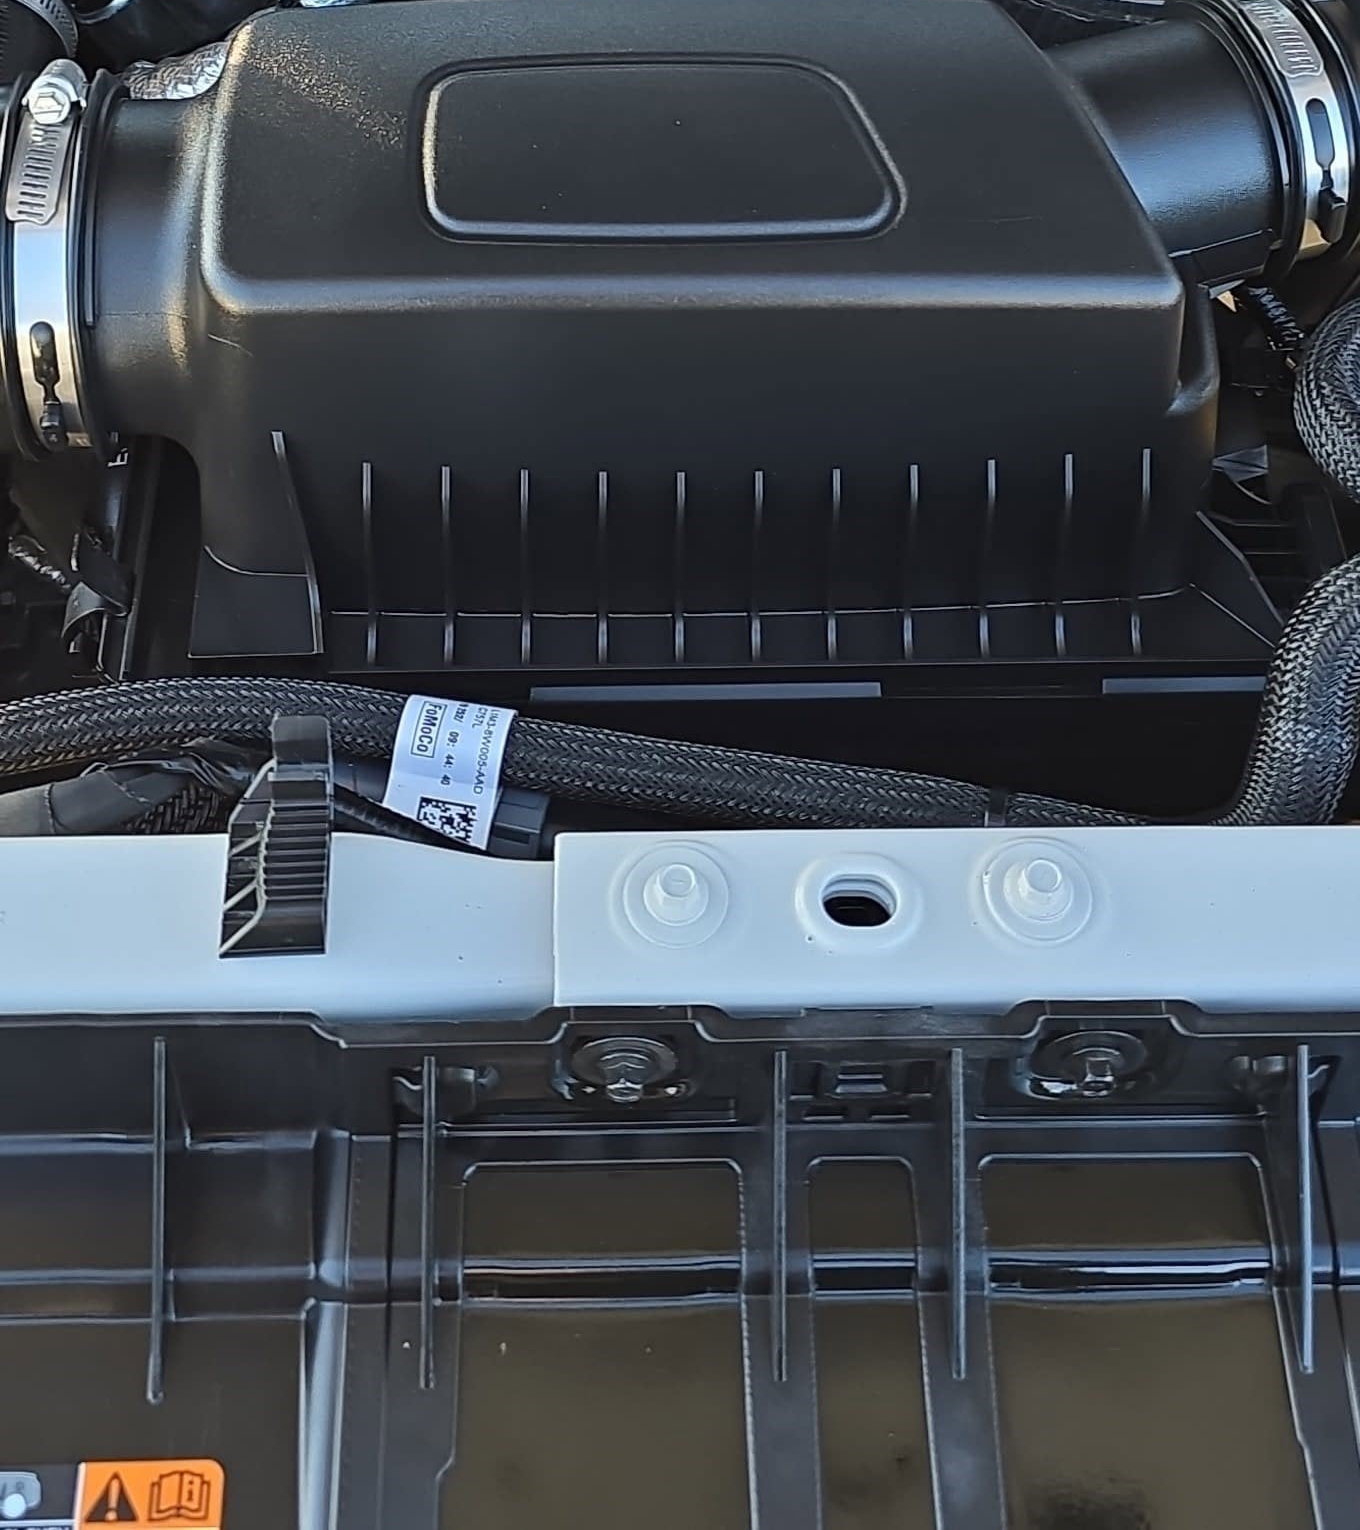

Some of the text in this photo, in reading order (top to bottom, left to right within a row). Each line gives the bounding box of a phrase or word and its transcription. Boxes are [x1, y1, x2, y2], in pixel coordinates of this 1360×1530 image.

[417, 703, 442, 752] FoMoCo
[447, 730, 459, 748] 09:
[443, 753, 455, 768] 44:
[440, 773, 451, 786] 40
